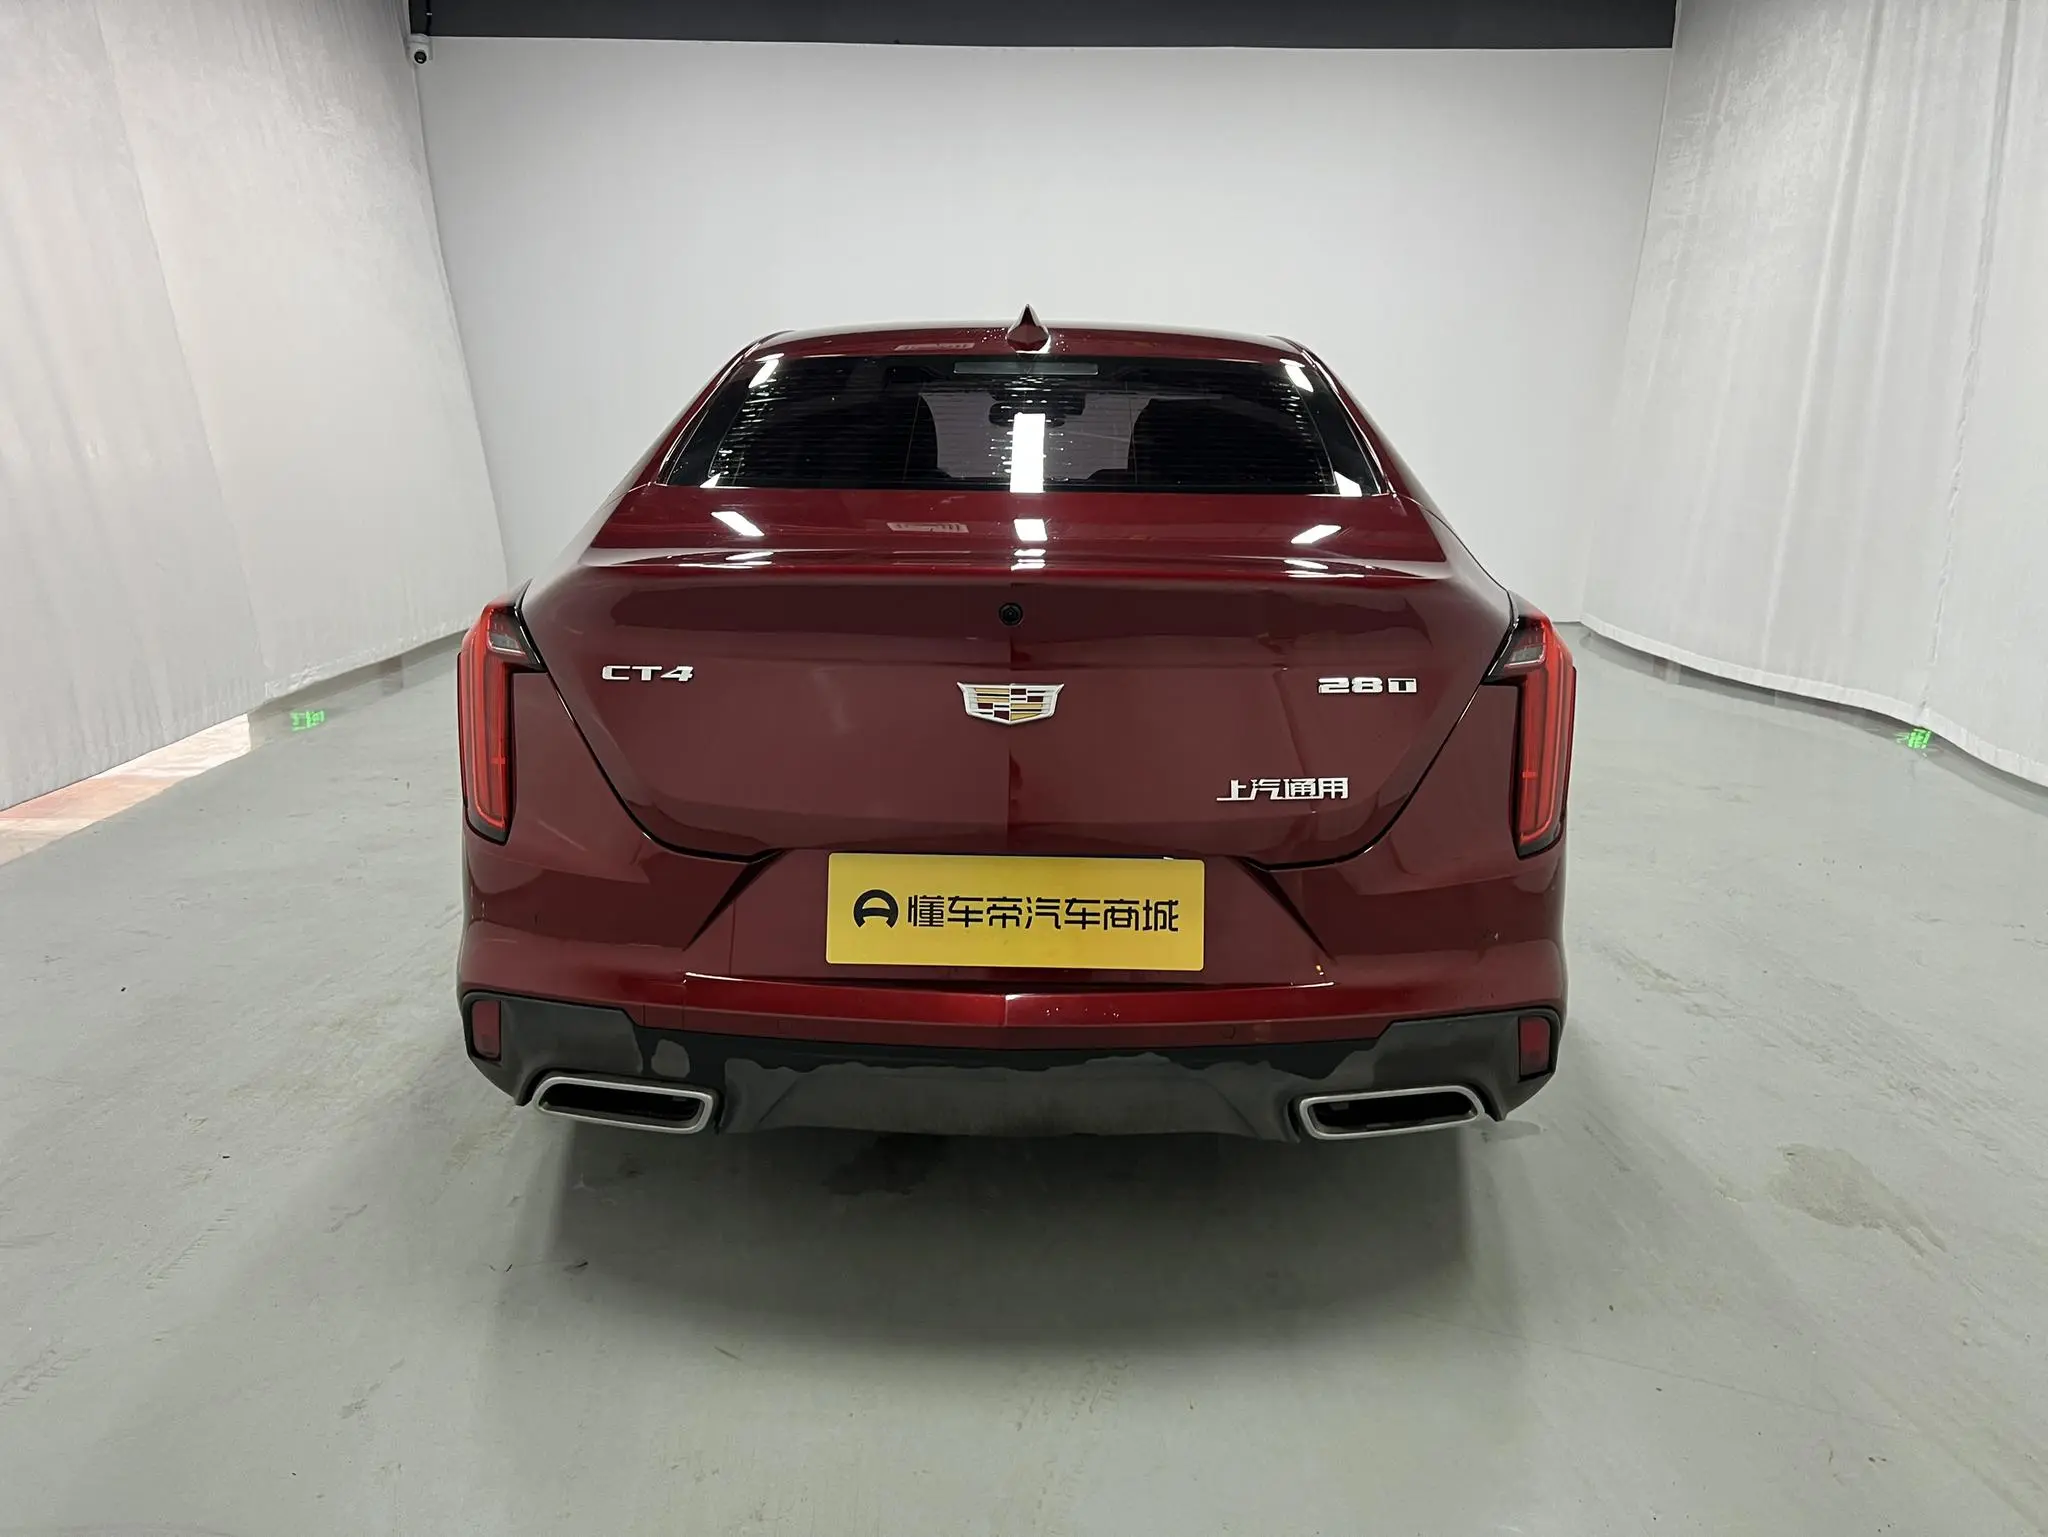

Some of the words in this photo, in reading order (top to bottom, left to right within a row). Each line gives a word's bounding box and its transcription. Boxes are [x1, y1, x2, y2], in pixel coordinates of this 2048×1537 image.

[602, 665, 694, 682] CT4
[1317, 676, 1417, 694] 28T
[1216, 777, 1349, 801] 上汽通用
[907, 893, 1179, 932] 懂车帝汽车商城
